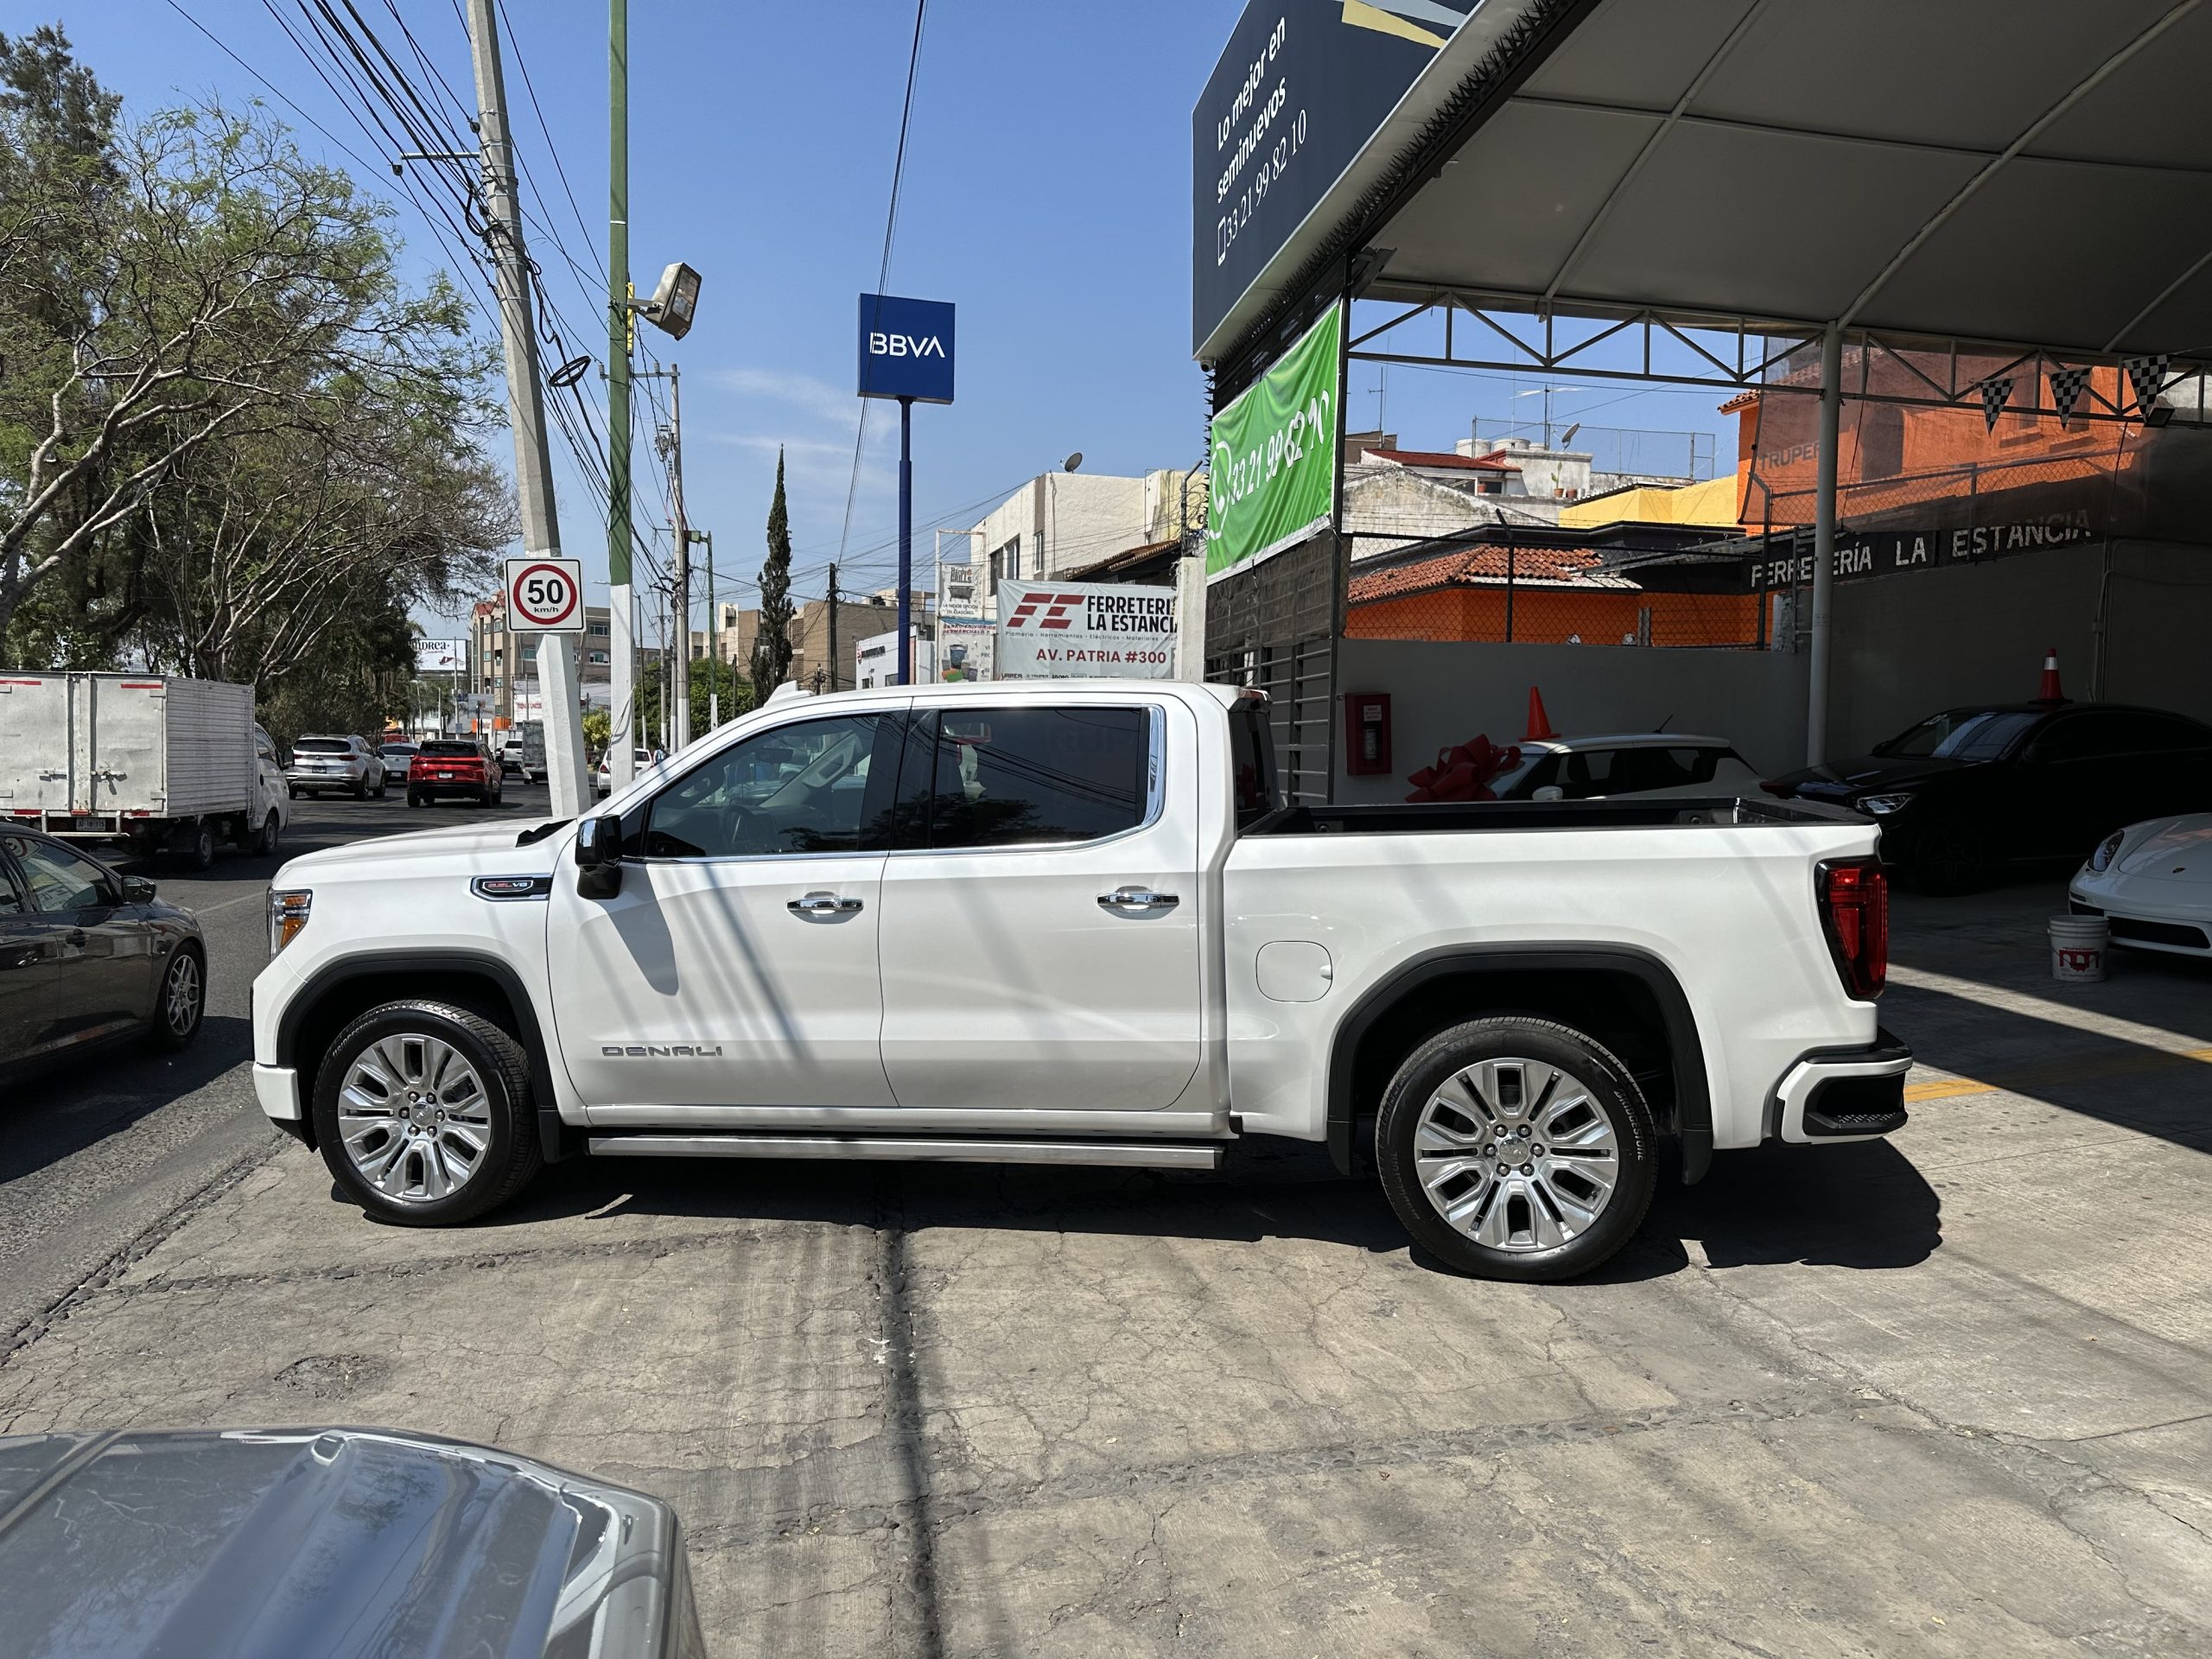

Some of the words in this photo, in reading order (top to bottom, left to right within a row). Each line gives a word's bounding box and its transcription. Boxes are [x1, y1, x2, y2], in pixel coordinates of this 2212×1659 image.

[1217, 116, 1230, 152] Lo
[1232, 49, 1267, 128] mejor
[1268, 16, 1287, 63] en
[1217, 76, 1287, 204] seminuevos
[1226, 207, 1238, 248] 33
[1241, 186, 1253, 229] 21
[1255, 162, 1270, 207] 99
[1273, 137, 1288, 181] 82
[1292, 109, 1307, 156] 10
[869, 332, 946, 359] BBVA
[1247, 442, 1264, 495] 21
[1266, 429, 1283, 483] 99
[1307, 390, 1329, 450] 10
[1751, 541, 1872, 588] FERREERÍA
[1895, 536, 1928, 567] LA
[1951, 509, 2092, 558] ESTANCIA
[527, 579, 563, 605] 50
[1087, 594, 1172, 616] FERRETERI
[1087, 613, 1107, 632] LA
[1036, 648, 1063, 661] AV.
[1066, 649, 1122, 664] PATRIA
[1124, 651, 1167, 664] #300
[601, 1046, 723, 1057] DENALI
